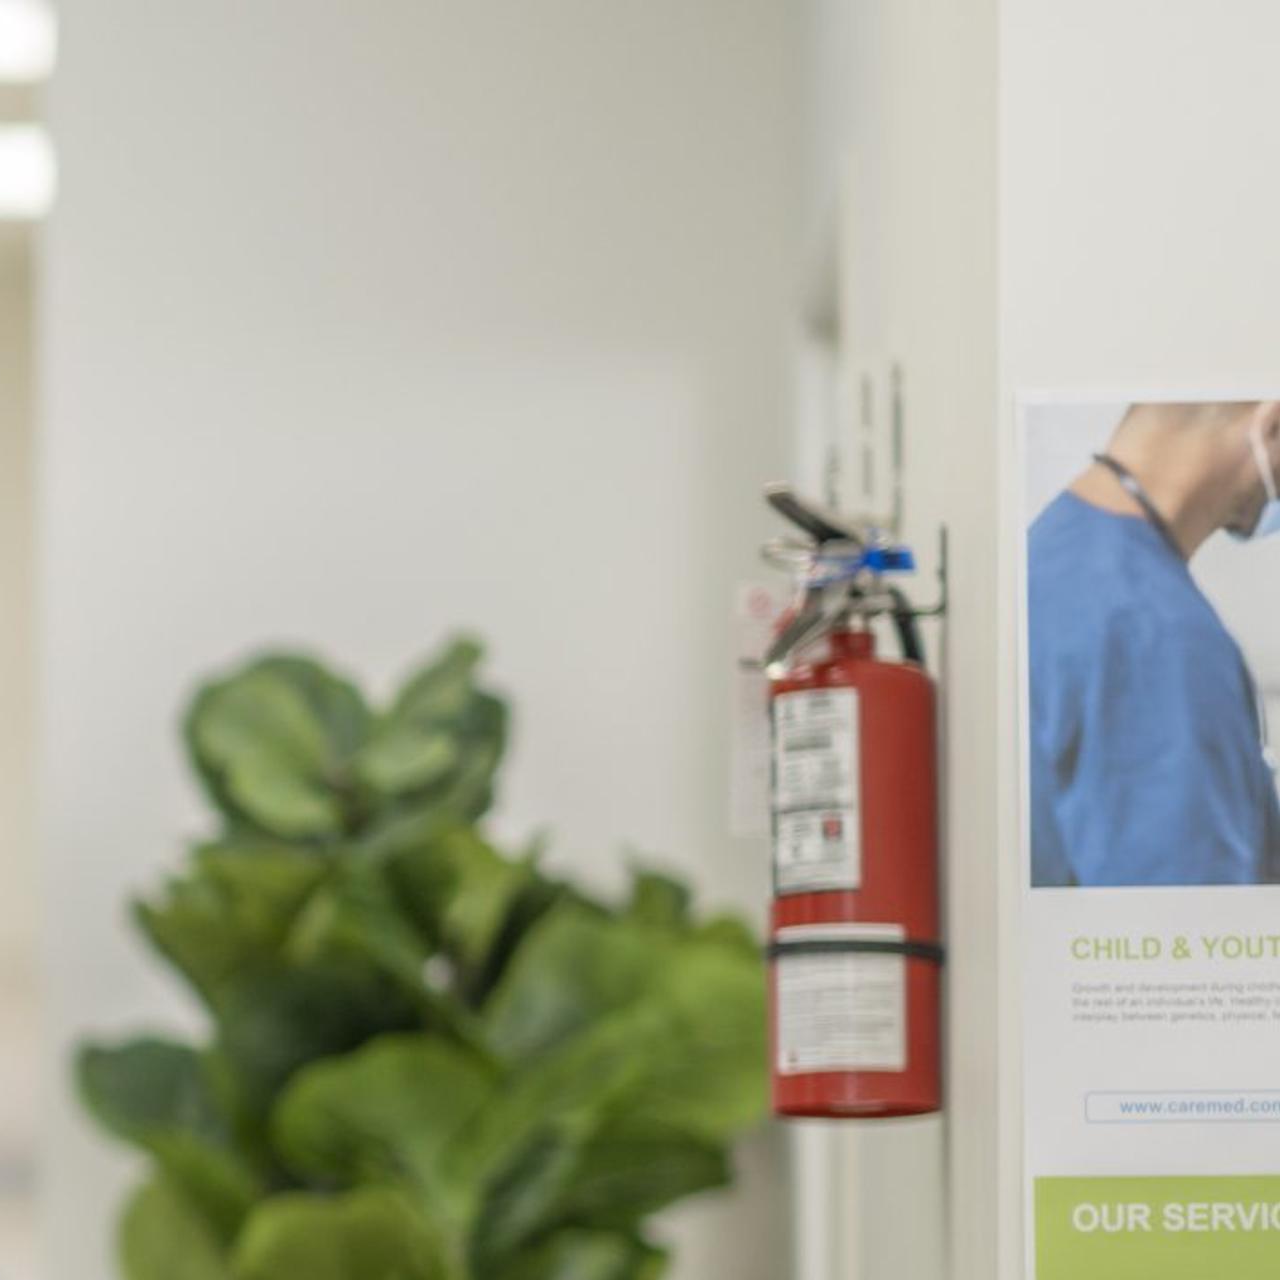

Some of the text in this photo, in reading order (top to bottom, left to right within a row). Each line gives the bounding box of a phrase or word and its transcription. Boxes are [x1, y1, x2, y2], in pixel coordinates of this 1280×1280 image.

[1071, 935, 1280, 960] CHILD & YOUT
[1072, 1203, 1151, 1232] OUR
